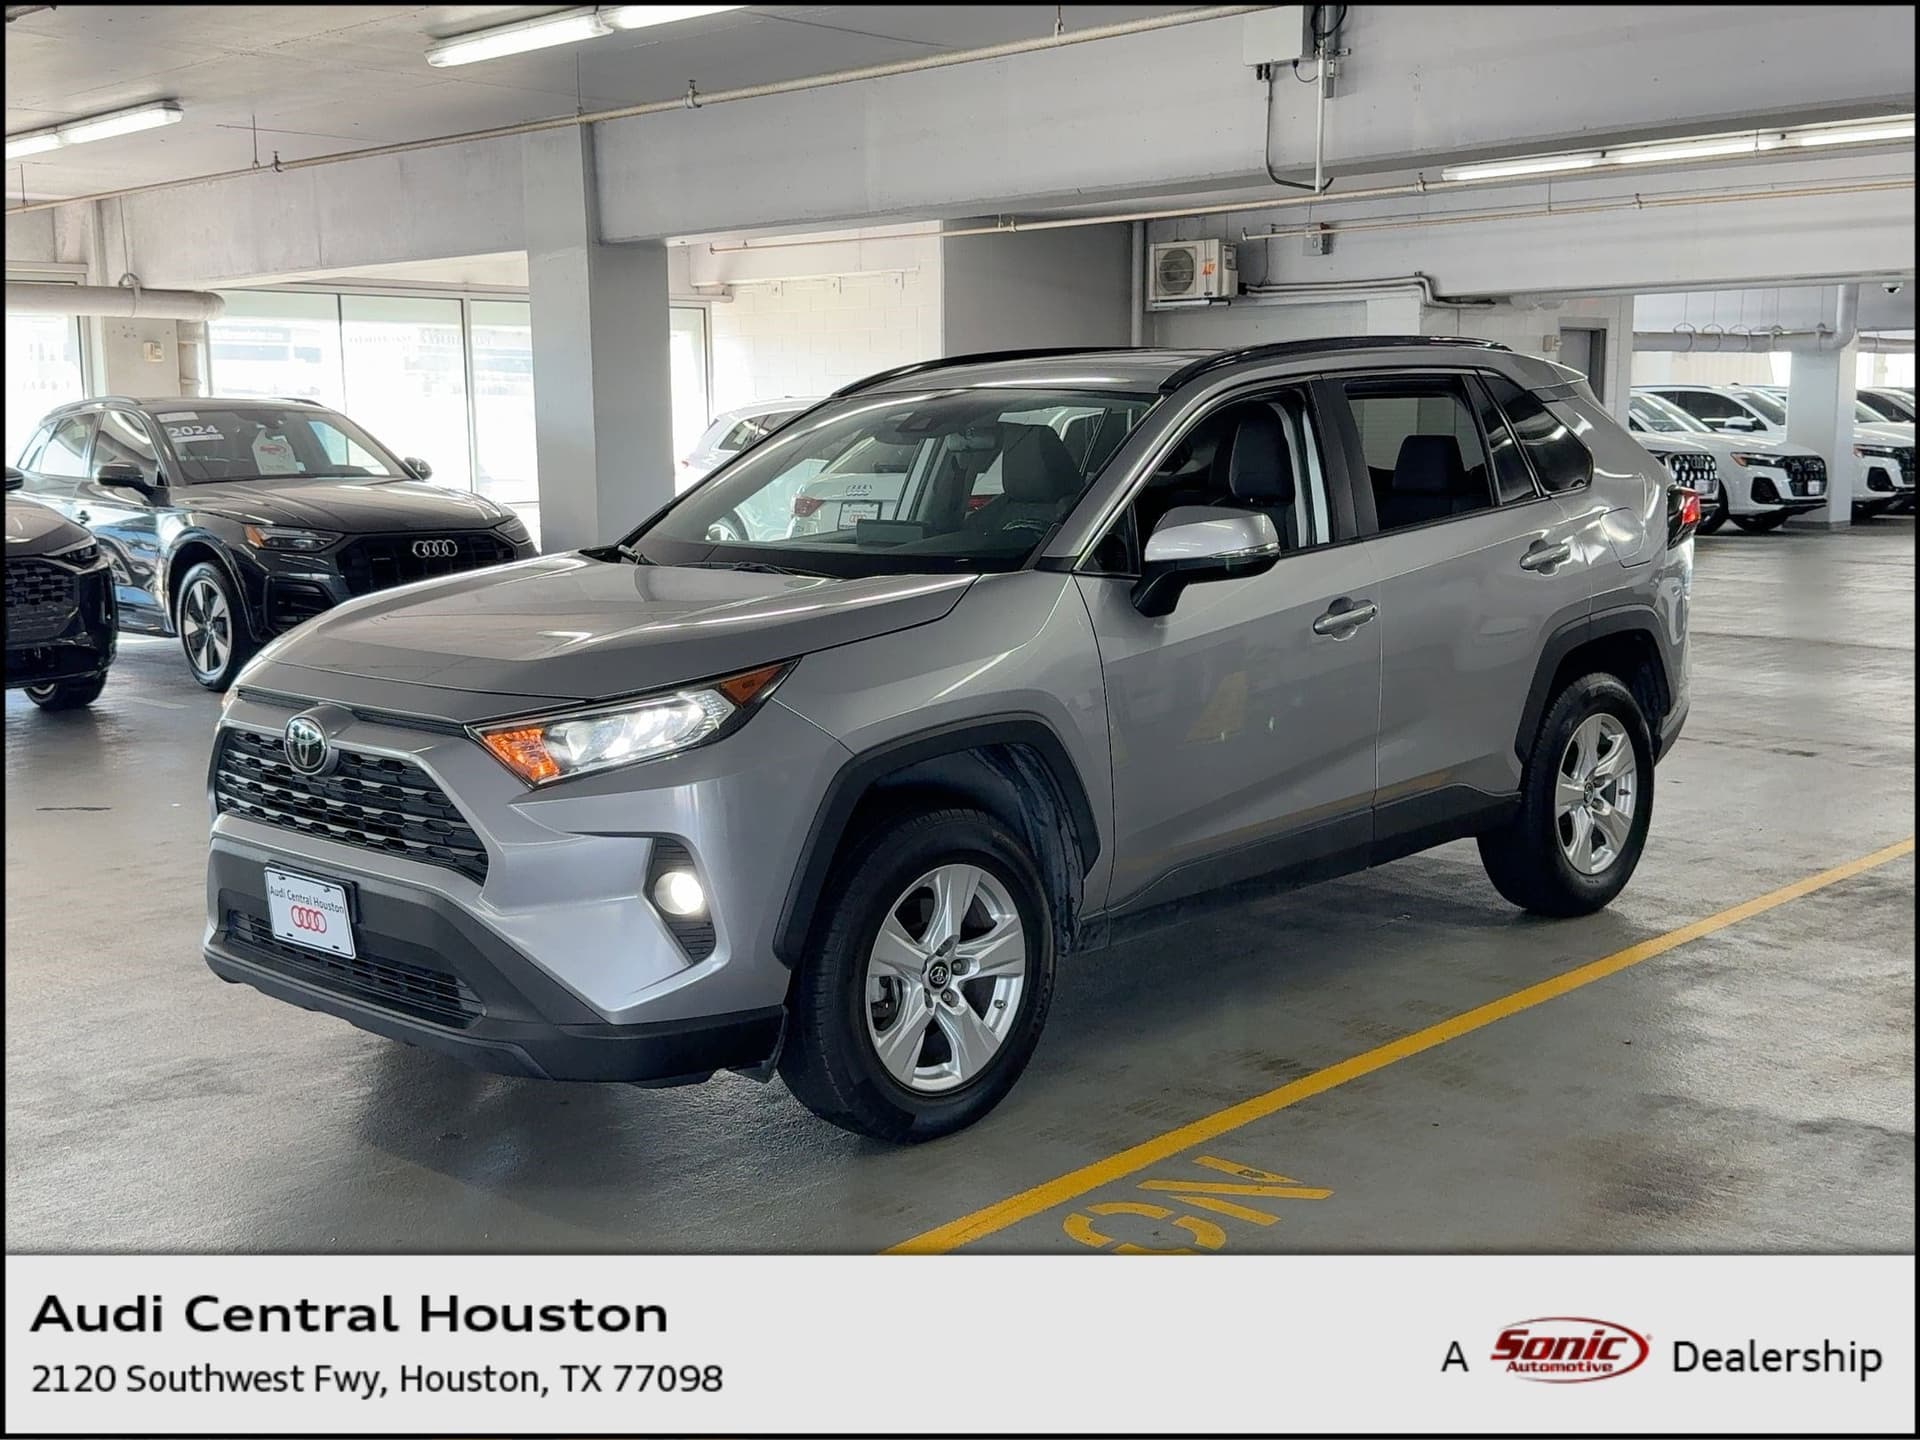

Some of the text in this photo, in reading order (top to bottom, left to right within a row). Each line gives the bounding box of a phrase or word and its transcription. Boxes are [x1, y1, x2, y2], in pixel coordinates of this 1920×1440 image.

[168, 425, 218, 436] 2024
[270, 886, 344, 913] Audi Central Houston
